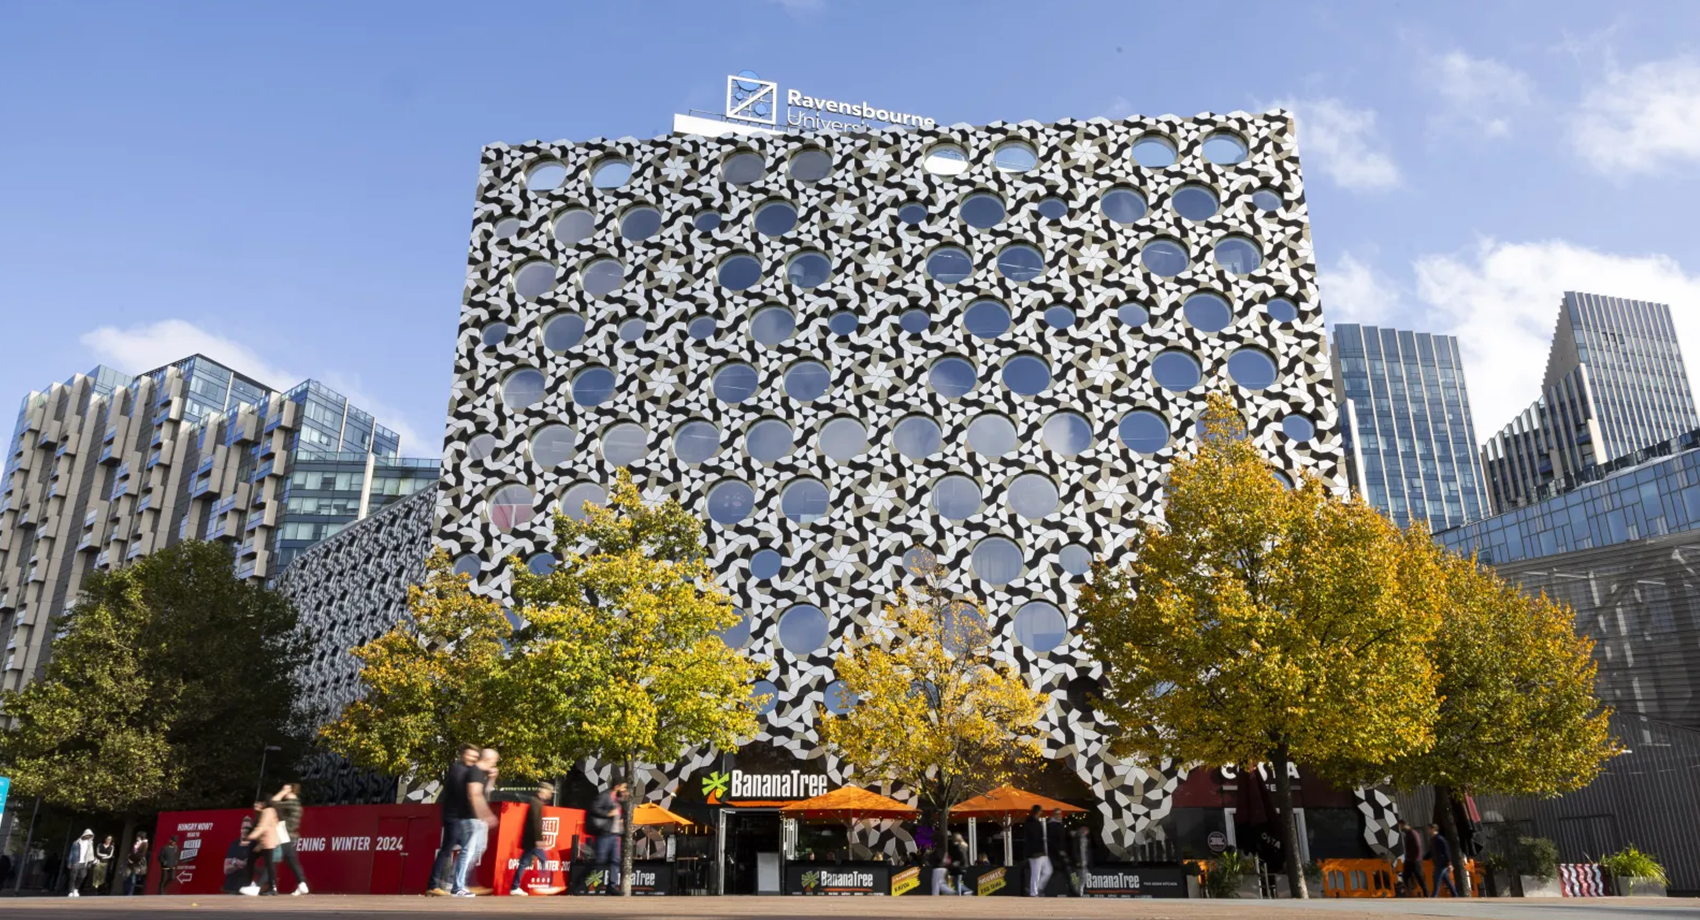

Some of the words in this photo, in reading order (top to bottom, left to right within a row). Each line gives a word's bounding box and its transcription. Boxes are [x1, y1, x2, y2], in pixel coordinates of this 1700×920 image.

[787, 88, 935, 126] Ravensbourne
[731, 769, 827, 797] BananaTree
[331, 837, 371, 851] WINTER
[375, 836, 403, 851] 2024
[820, 870, 873, 887] BananaTree
[1086, 872, 1140, 888] BananaTree
